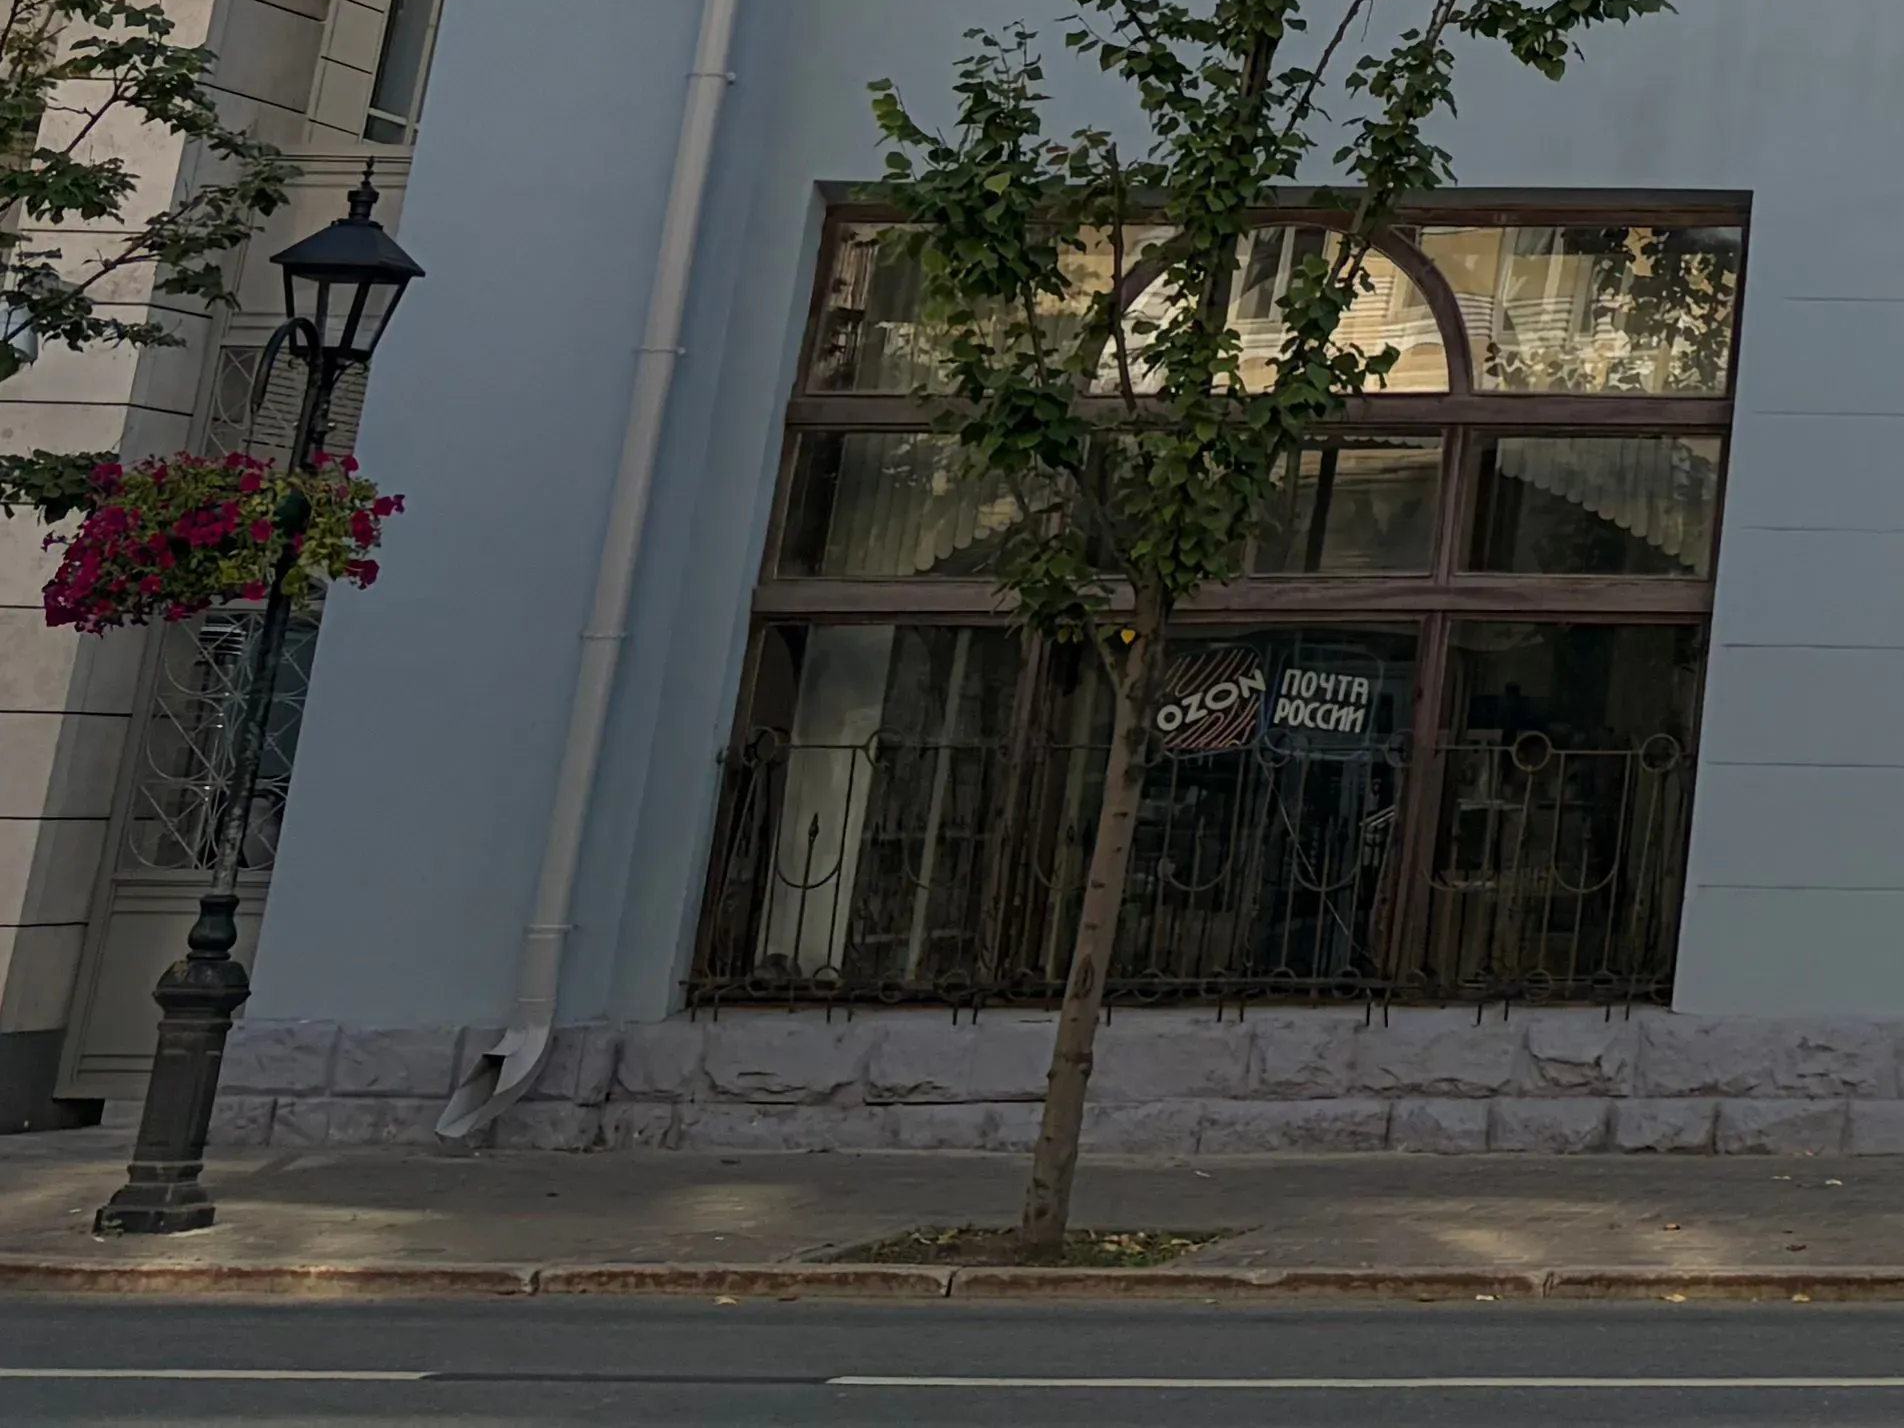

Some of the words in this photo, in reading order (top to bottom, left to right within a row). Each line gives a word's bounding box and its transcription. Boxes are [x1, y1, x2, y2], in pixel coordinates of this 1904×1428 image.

[1157, 669, 1266, 731] OZON
[1281, 669, 1369, 704] ПОЧТА
[1273, 699, 1366, 734] РОССИИ
